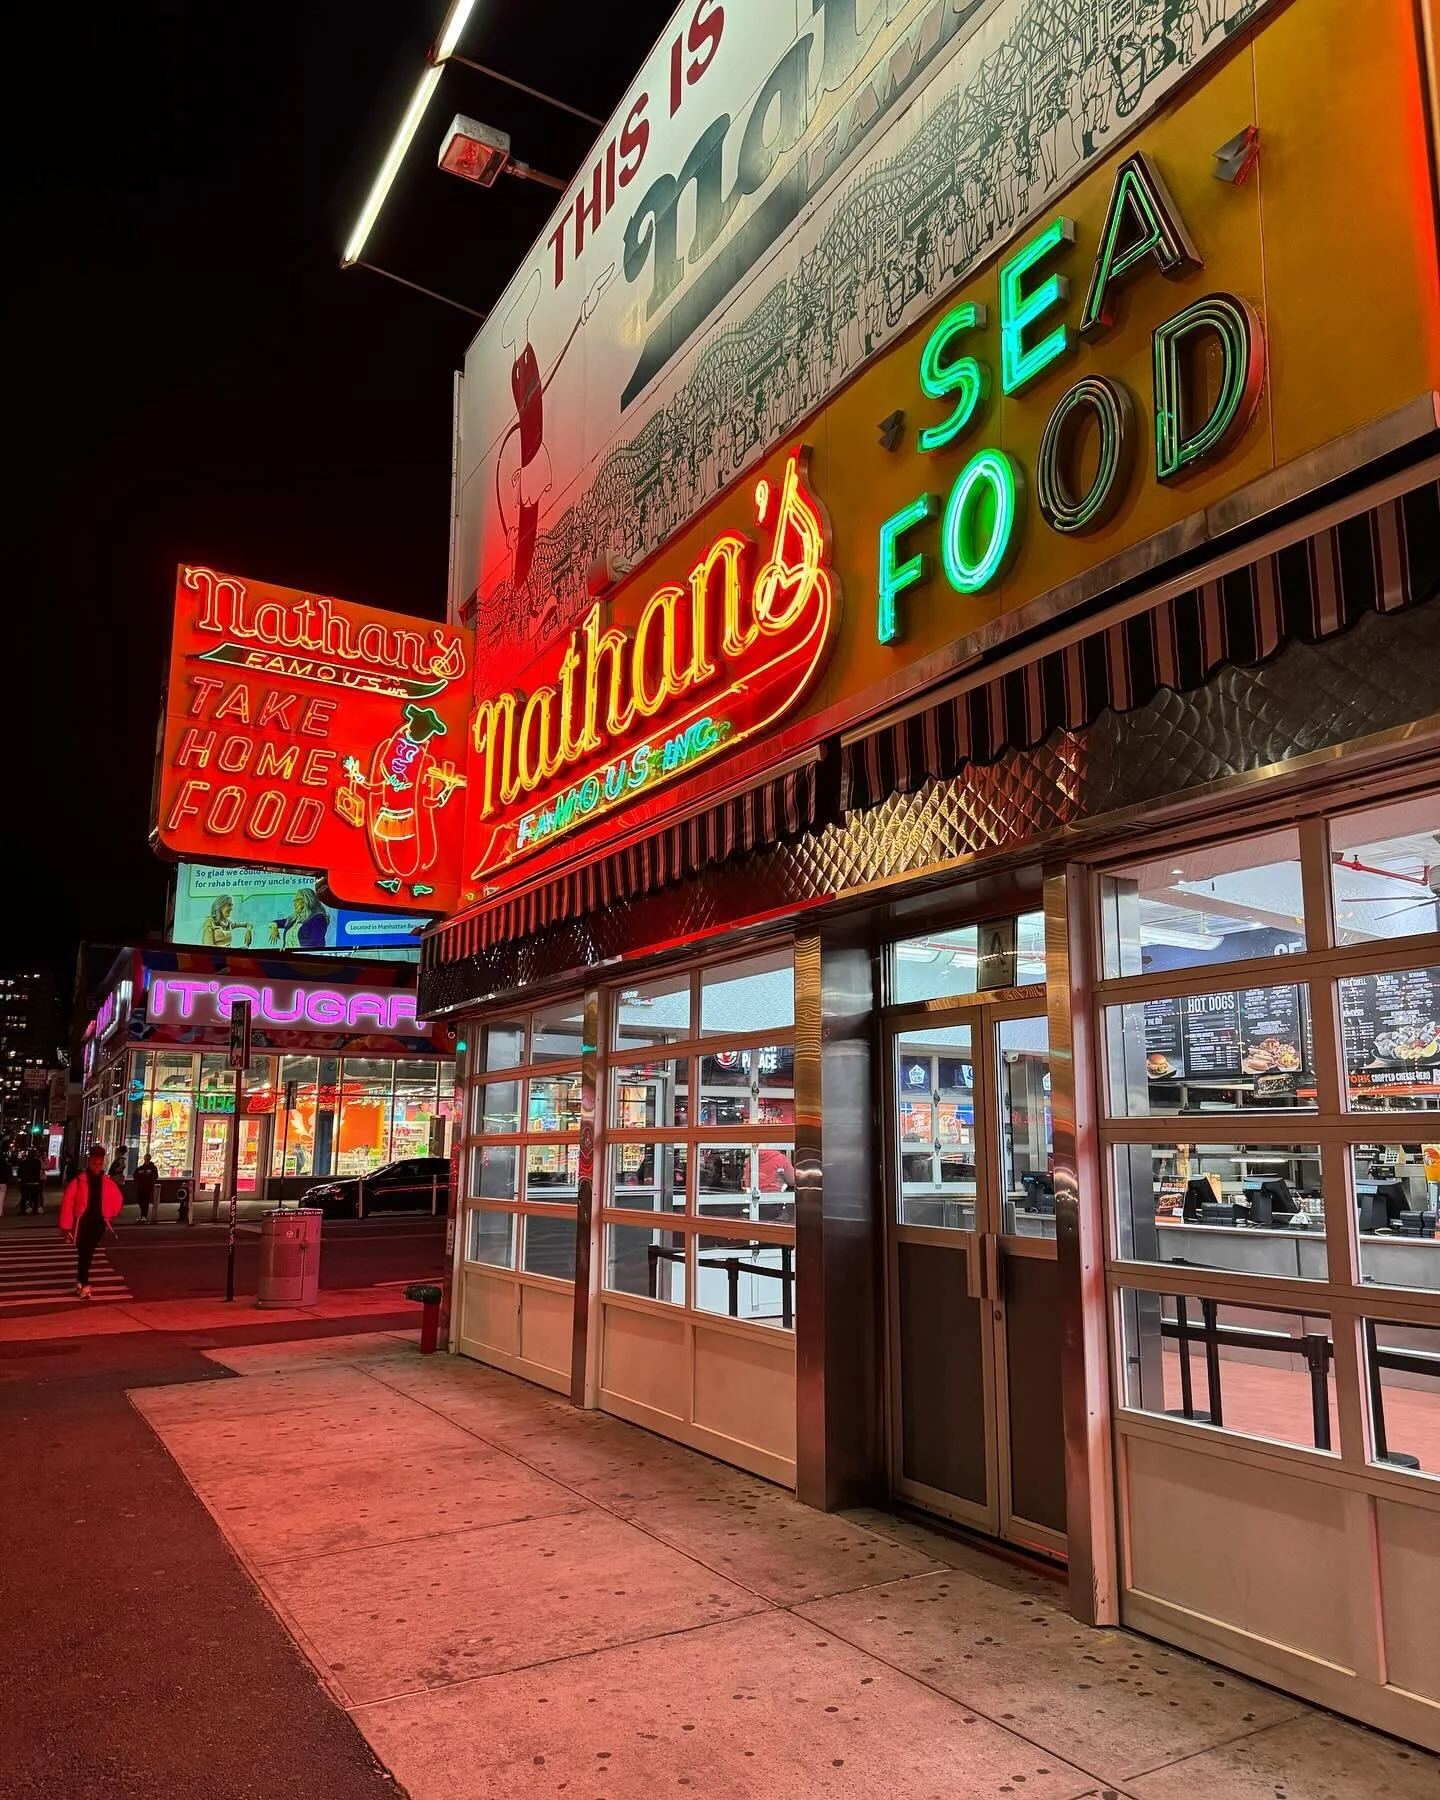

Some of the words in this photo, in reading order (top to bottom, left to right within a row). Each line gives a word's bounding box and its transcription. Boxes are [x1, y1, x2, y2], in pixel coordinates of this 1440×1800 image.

[547, 92, 649, 290] THIS
[669, 0, 725, 119] IS
[919, 151, 1202, 453] SEA
[879, 292, 1262, 645] FOOD
[245, 652, 382, 688] FAMOUS
[191, 676, 337, 736] TAKE
[179, 729, 337, 785] HOME
[169, 781, 326, 844] FOOD
[517, 745, 651, 848] FAMOUS
[195, 880, 206, 888] for
[208, 879, 231, 888] rehab
[233, 879, 252, 887] after
[268, 877, 296, 885] uncle's
[207, 869, 225, 878] glad
[1188, 998, 1206, 1013] HOT
[1209, 994, 1235, 1011] DOGS
[1371, 1072, 1396, 1083] CHOPPED
